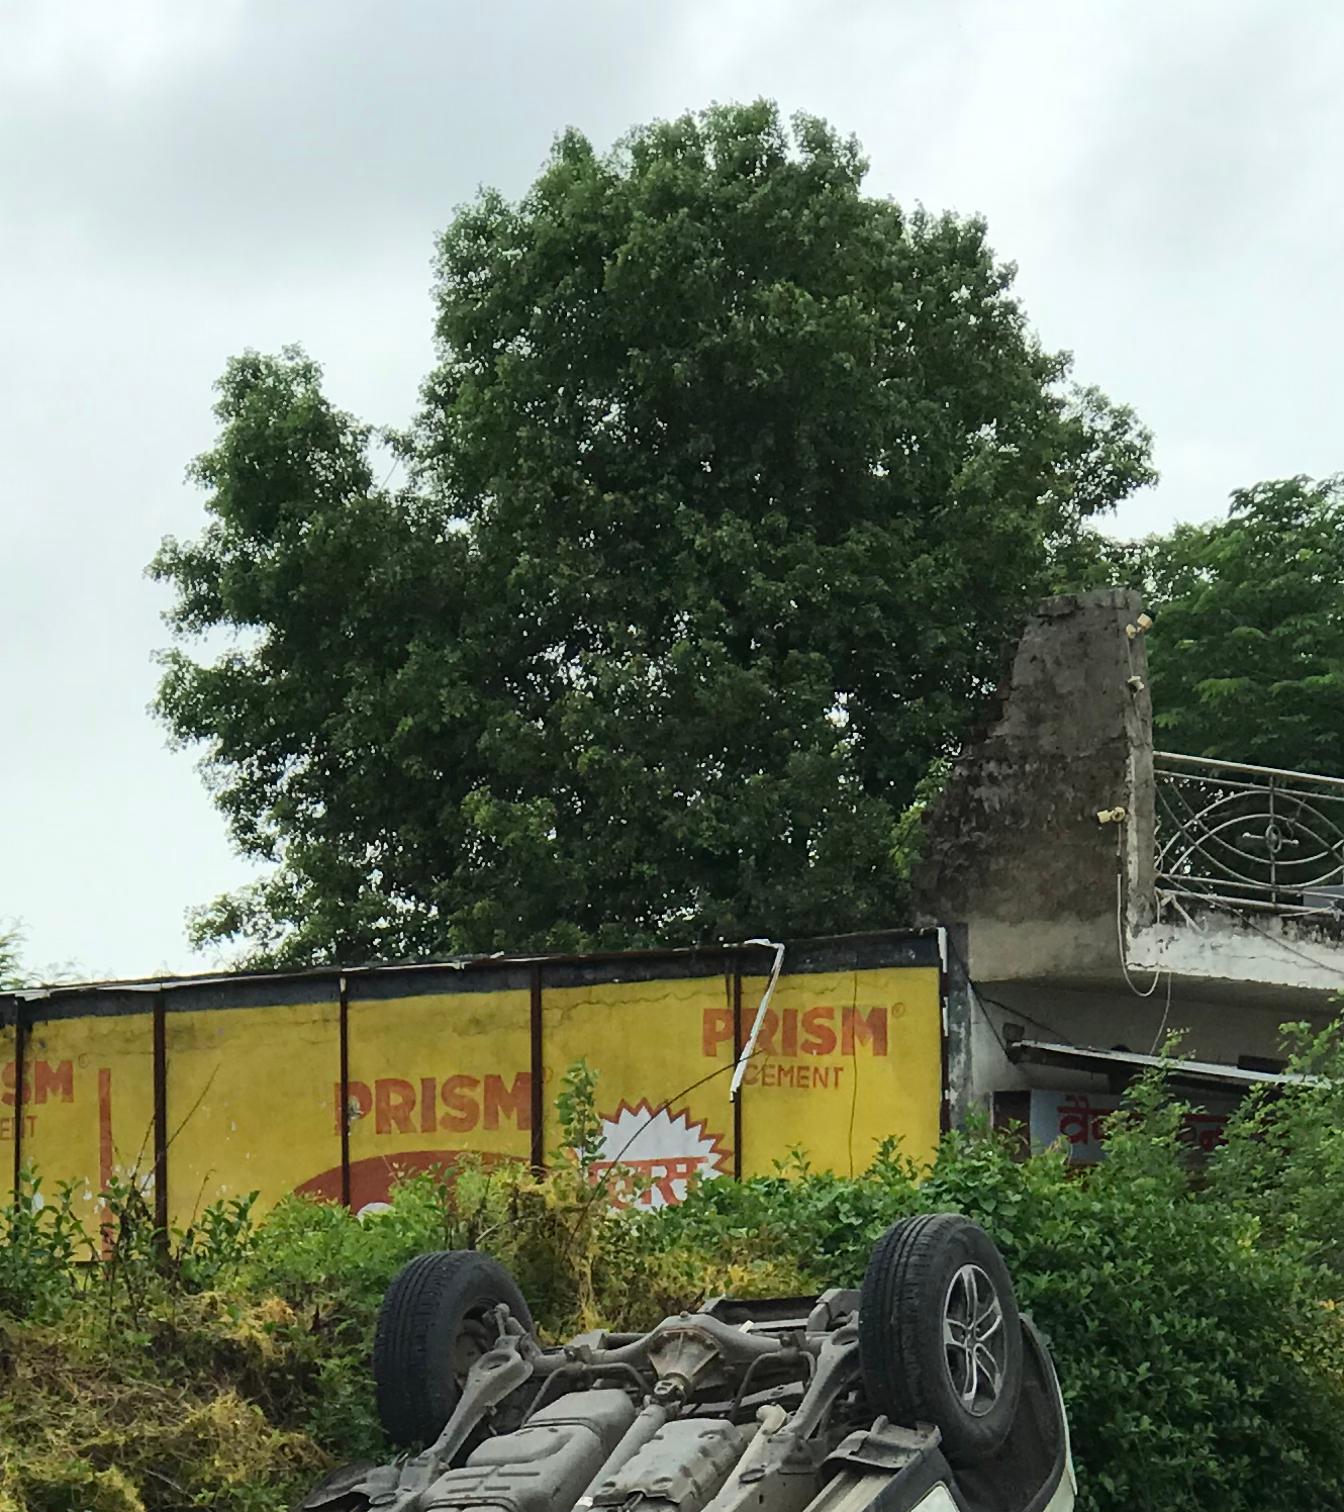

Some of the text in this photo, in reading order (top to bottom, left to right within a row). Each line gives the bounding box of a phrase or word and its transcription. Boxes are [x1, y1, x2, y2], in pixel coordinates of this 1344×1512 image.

[702, 1006, 888, 1057] PRISM
[743, 1063, 844, 1089] CEMENT
[334, 1072, 532, 1137] PRISM
